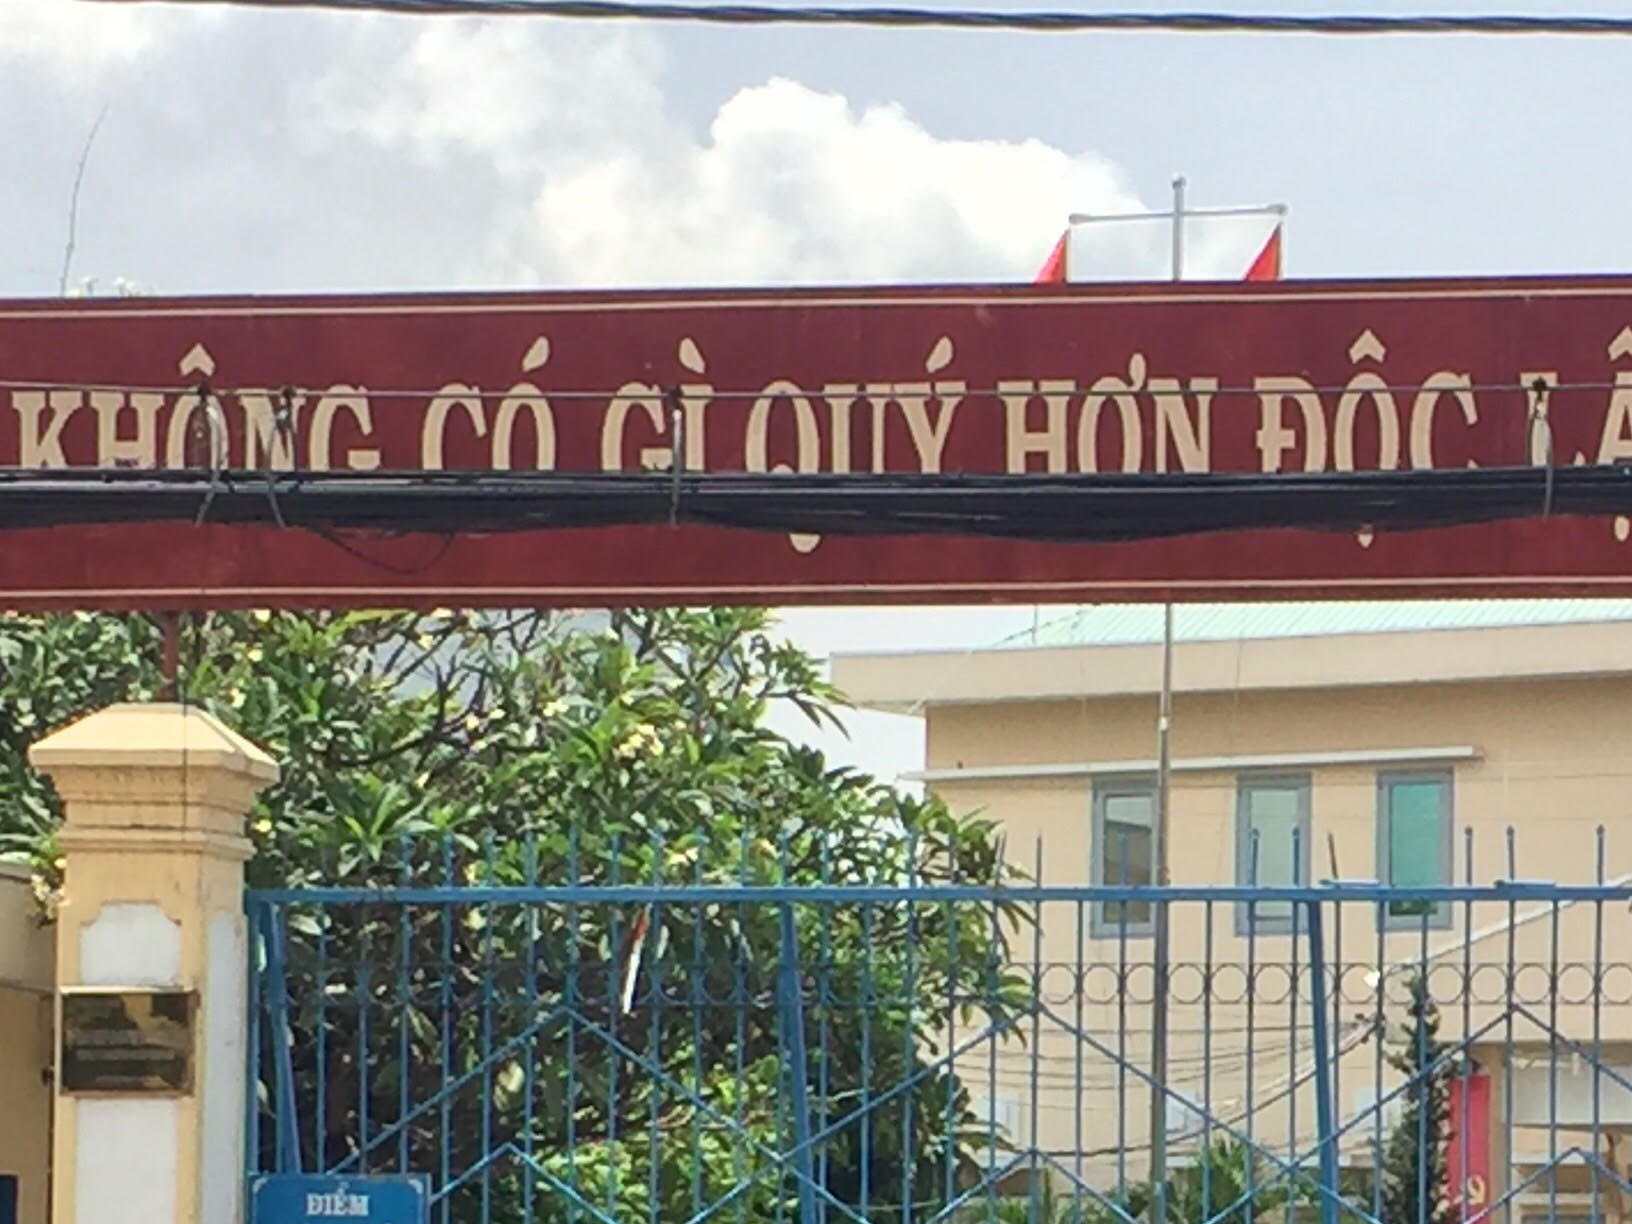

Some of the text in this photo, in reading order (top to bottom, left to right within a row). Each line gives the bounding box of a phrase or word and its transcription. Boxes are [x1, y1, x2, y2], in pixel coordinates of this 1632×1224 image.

[11, 342, 382, 471] KHÔNG
[421, 336, 557, 472] CÓ
[601, 337, 715, 473] GÌ
[744, 336, 967, 553] QUÝ
[997, 352, 1218, 475] HƠN
[1253, 328, 1479, 548] ĐỘC
